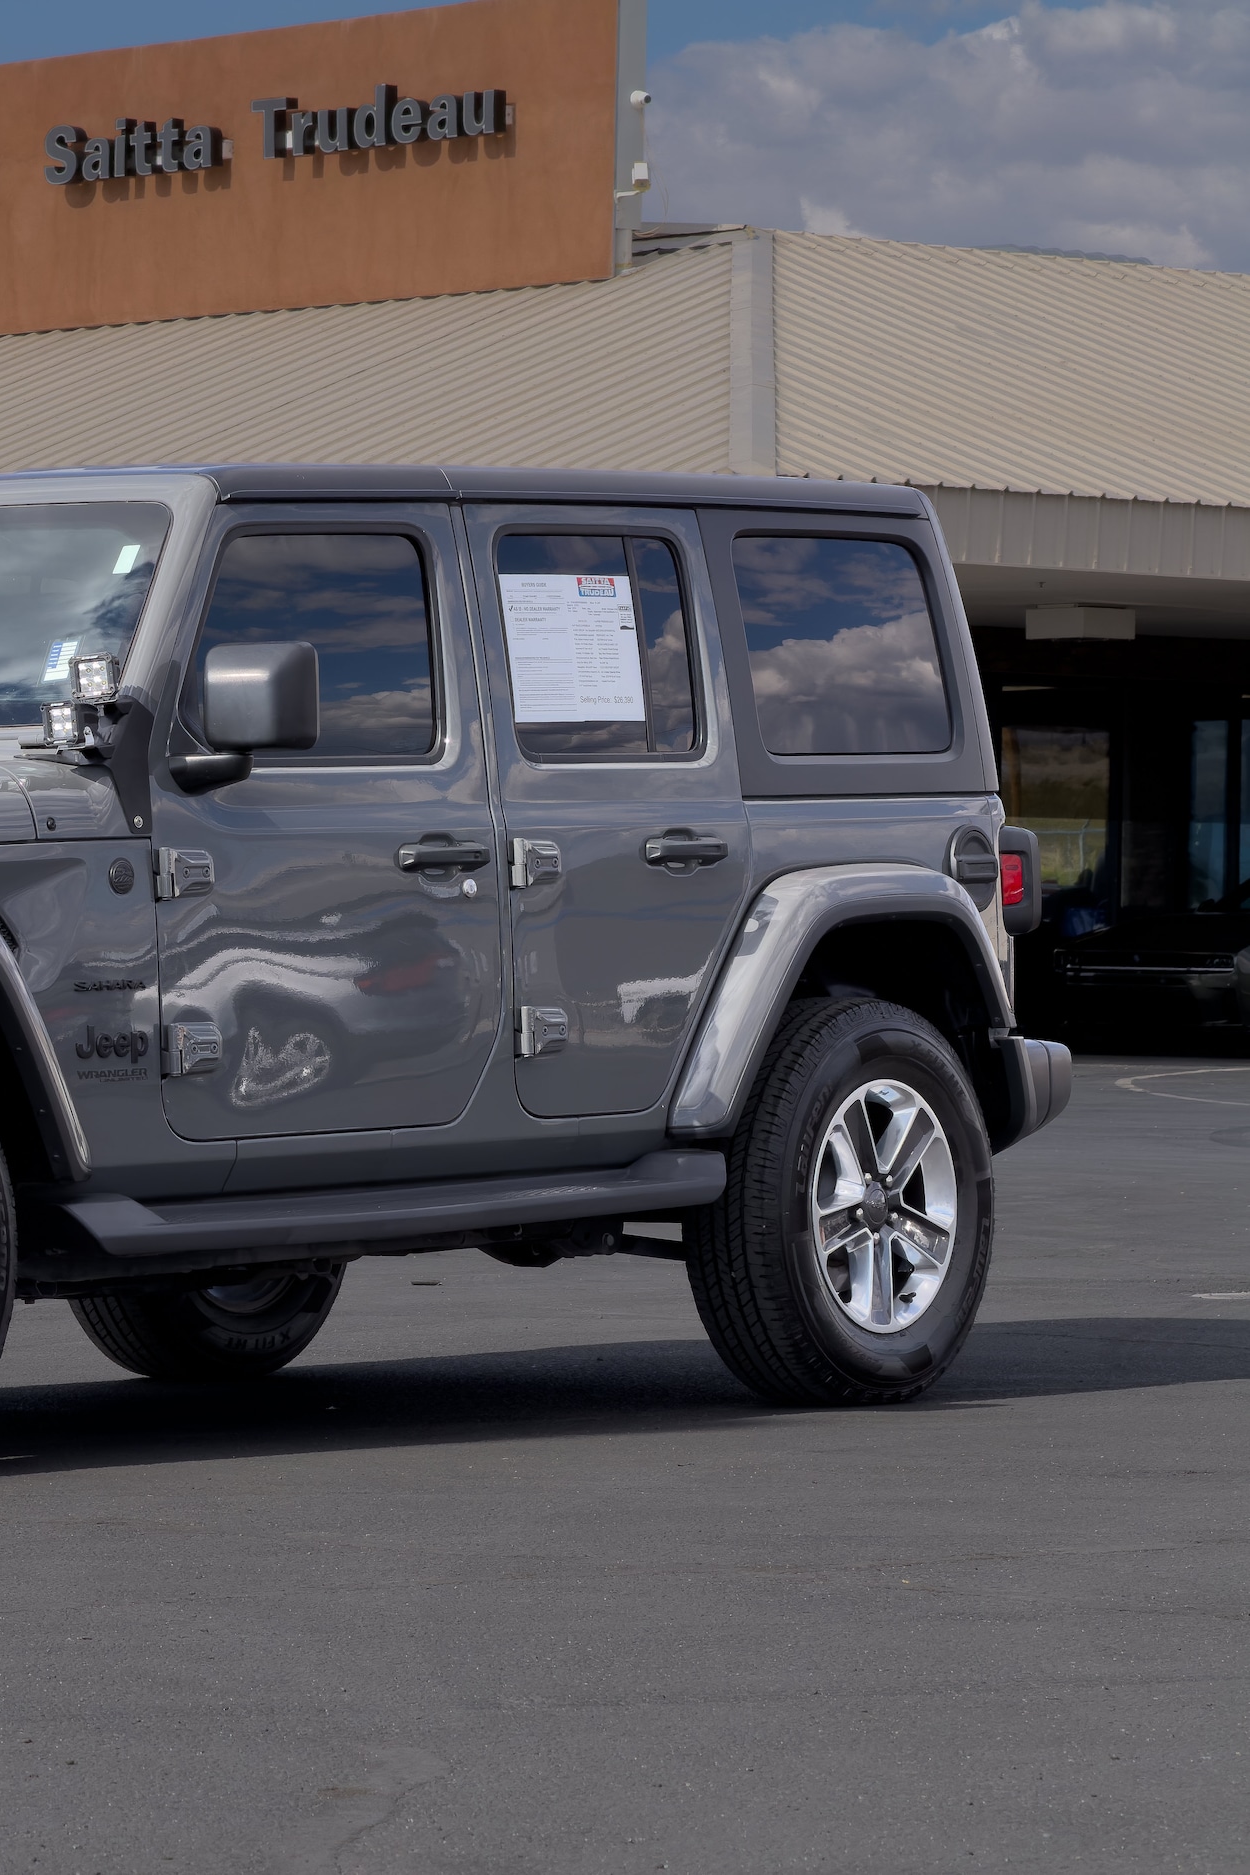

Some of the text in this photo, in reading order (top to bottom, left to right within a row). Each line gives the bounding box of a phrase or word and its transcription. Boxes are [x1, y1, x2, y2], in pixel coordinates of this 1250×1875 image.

[44, 84, 507, 186] Saitta Trudeau
[581, 577, 611, 586] SAITTA
[580, 588, 615, 597] TRUDEAU
[579, 695, 597, 706] Selling
[597, 695, 612, 704] Price:
[73, 979, 147, 993] SAHARA
[75, 1024, 149, 1064] Jeep
[76, 1067, 148, 1080] WRANGLER
